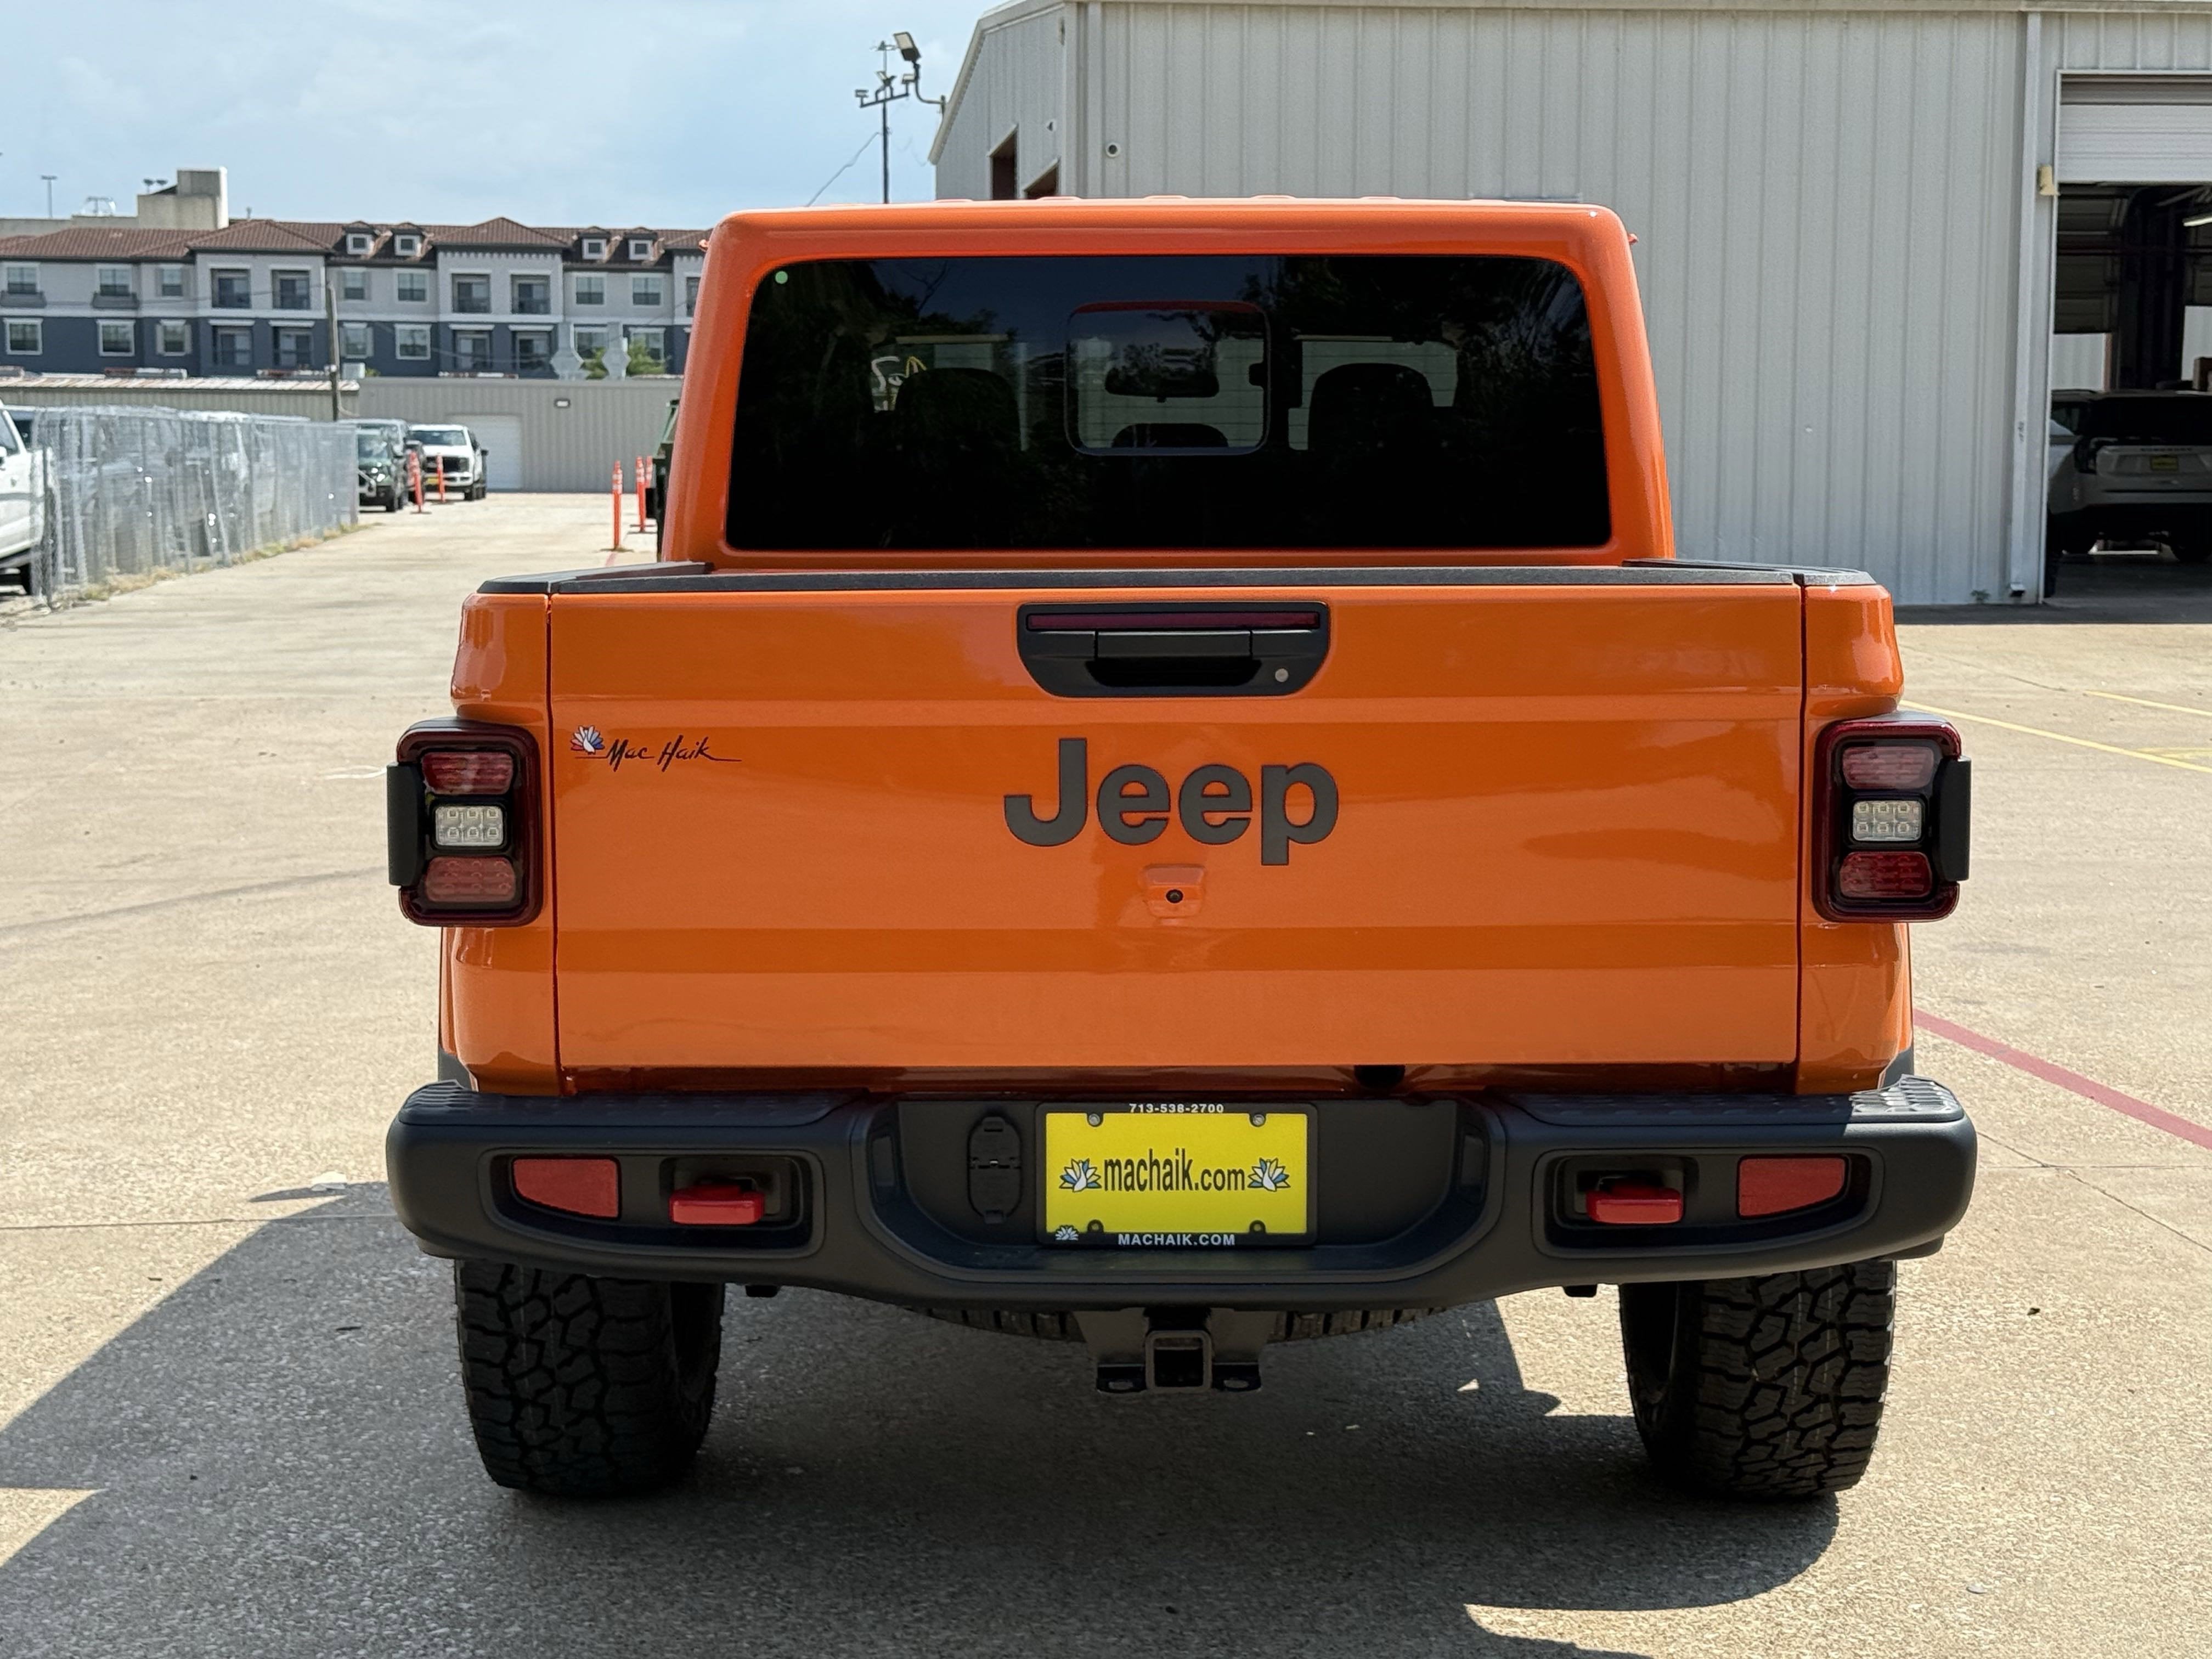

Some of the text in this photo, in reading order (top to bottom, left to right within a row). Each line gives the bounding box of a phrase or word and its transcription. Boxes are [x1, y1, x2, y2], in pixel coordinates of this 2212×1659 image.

[575, 734, 742, 772] Mac Haik
[1004, 738, 1339, 865] Jeep
[1129, 1103, 1224, 1113] 713-538-2700
[1104, 1148, 1245, 1192] machaik.com
[1118, 1234, 1235, 1246] MACHAIK.COM
